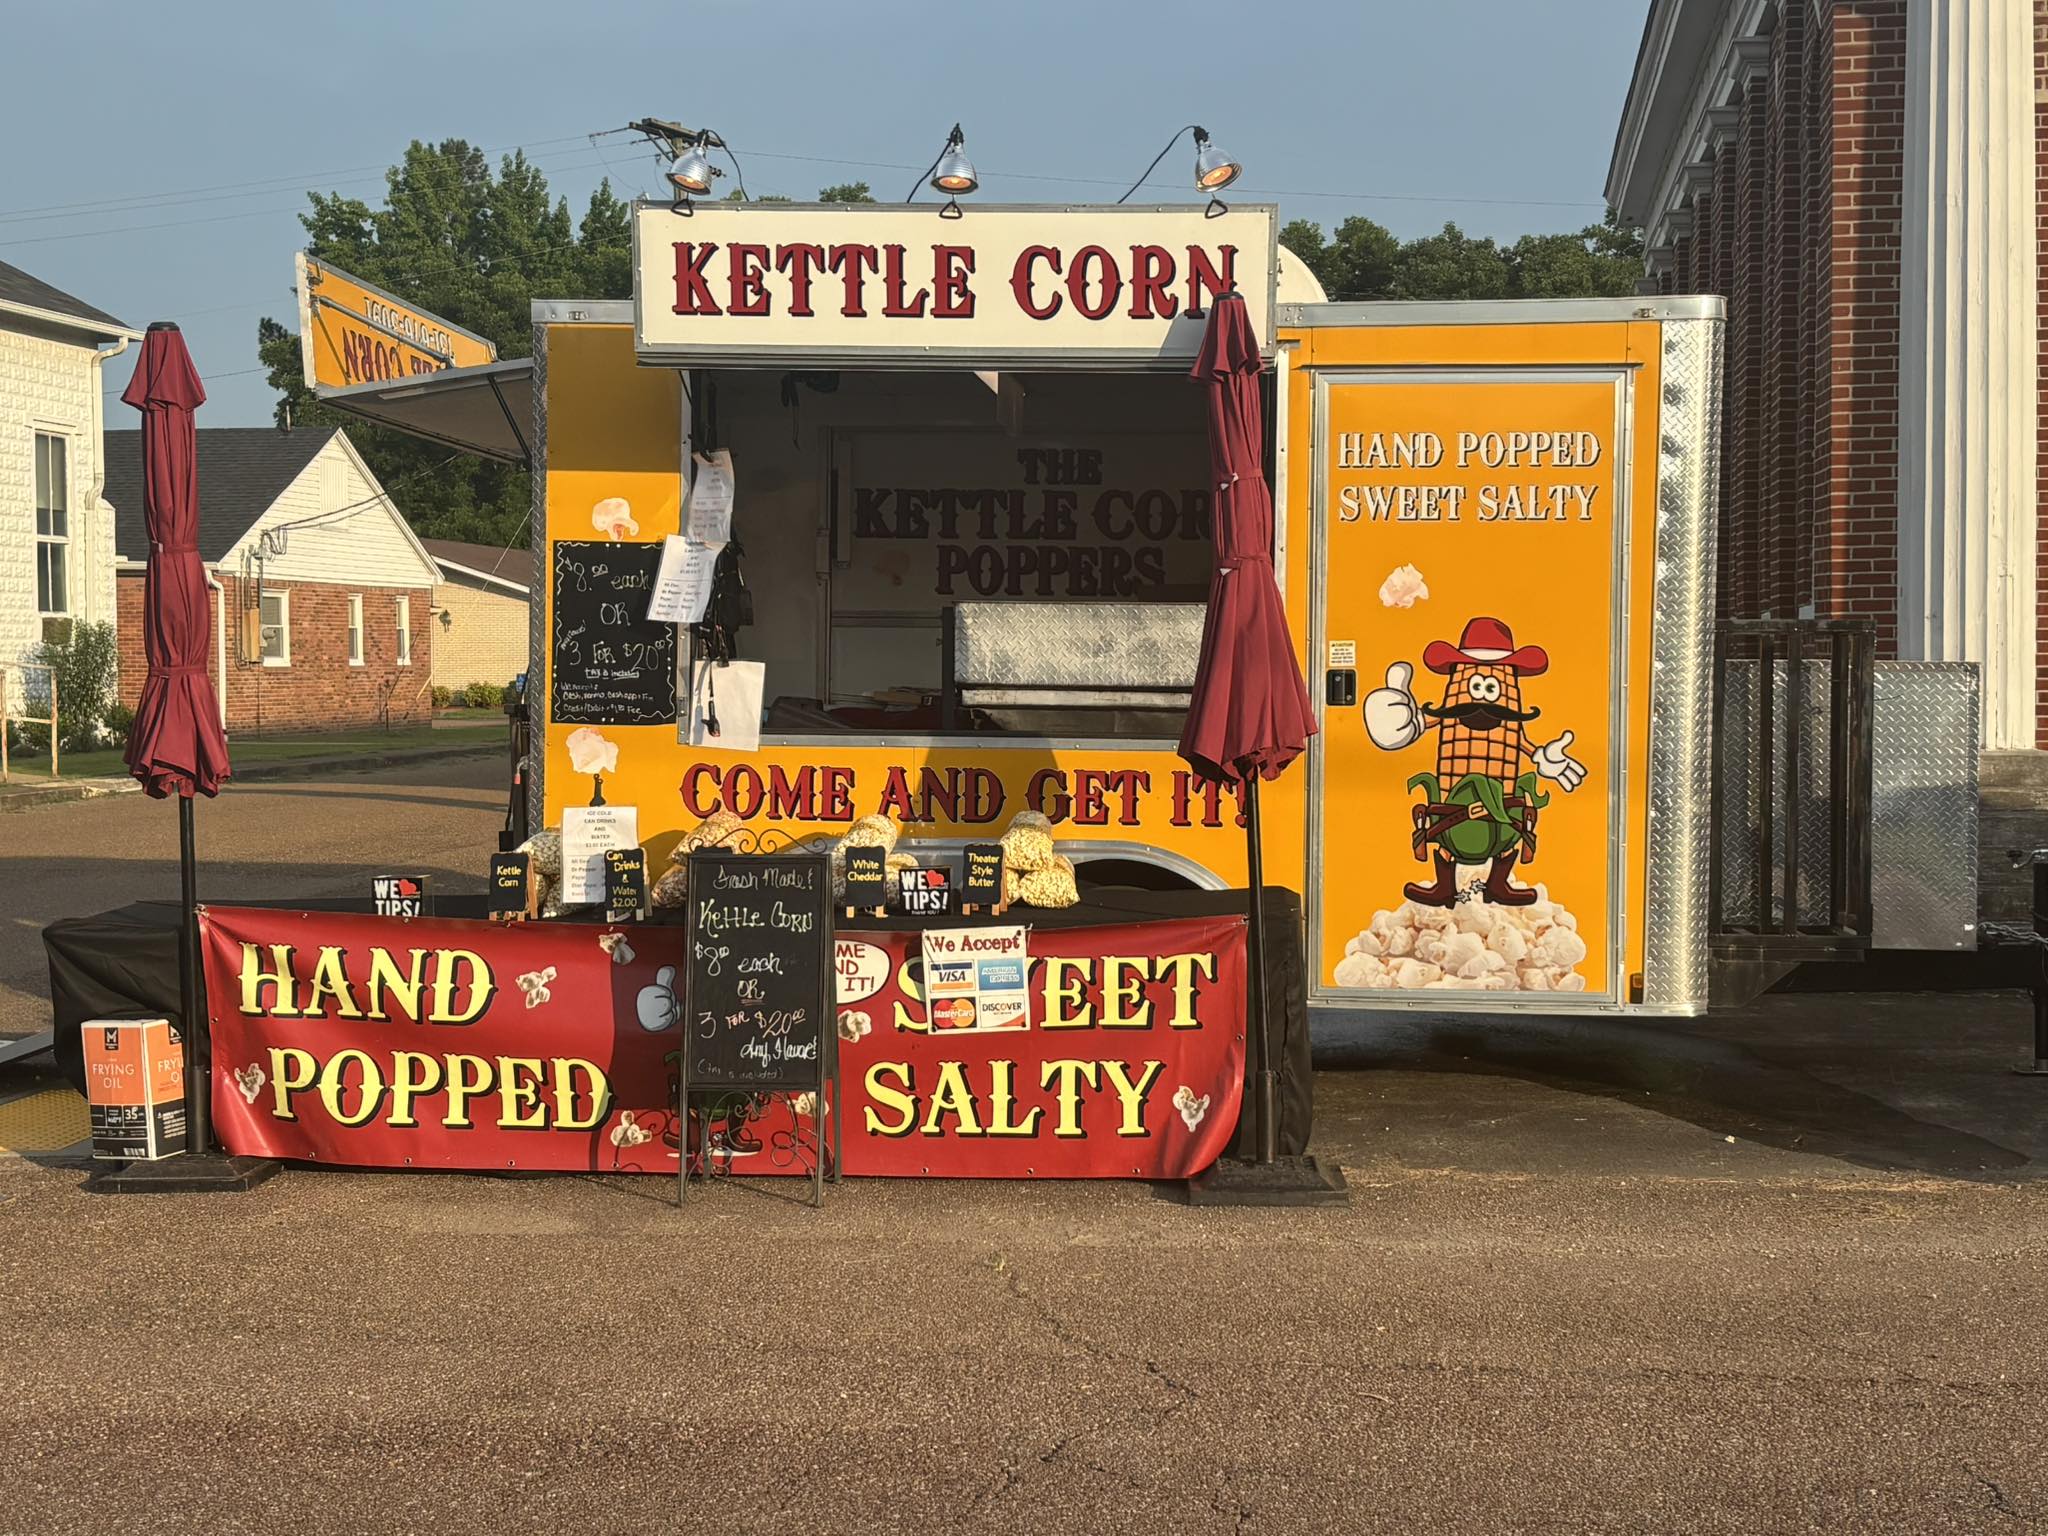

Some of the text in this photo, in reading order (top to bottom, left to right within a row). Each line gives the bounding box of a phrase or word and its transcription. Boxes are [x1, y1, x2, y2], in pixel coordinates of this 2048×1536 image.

[671, 242, 1238, 319] KETTLE CORN
[1338, 431, 1602, 468] HAND POPPED
[1017, 448, 1104, 486] THE
[1338, 485, 1600, 522] SWEET SALTY
[853, 488, 1211, 541] KETTLE COR
[935, 544, 1166, 597] POPPERS
[600, 601, 631, 626] OR
[569, 640, 582, 666] 3
[680, 764, 855, 821] COME
[880, 766, 1007, 822] AND
[1026, 769, 1151, 826] GET
[606, 851, 624, 861] Can
[852, 859, 880, 870] White
[968, 852, 1000, 864] Theater
[496, 865, 521, 876] Kettle
[613, 860, 641, 873] Drinks
[971, 864, 994, 876] Style
[498, 878, 519, 888] Corn
[622, 873, 629, 883] &
[847, 871, 884, 882] Cheddar
[900, 870, 927, 891] WE
[968, 876, 996, 888] Butter
[373, 879, 400, 899] WE
[612, 886, 637, 896] Water
[374, 899, 420, 918] TIPS!
[612, 898, 638, 908] $2.00
[902, 890, 949, 910] TIPS!
[932, 935, 1020, 953] We Accept
[737, 952, 783, 975] each
[237, 941, 500, 1026] HAND
[844, 976, 875, 992] IT!
[938, 970, 966, 982] VISA
[981, 1003, 1022, 1012] DISCOVER
[698, 1011, 717, 1039] 3
[92, 1063, 135, 1075] FRYING
[103, 1077, 123, 1089] OIL
[266, 1047, 615, 1131] POPPED
[863, 1059, 1167, 1138] SALTY
